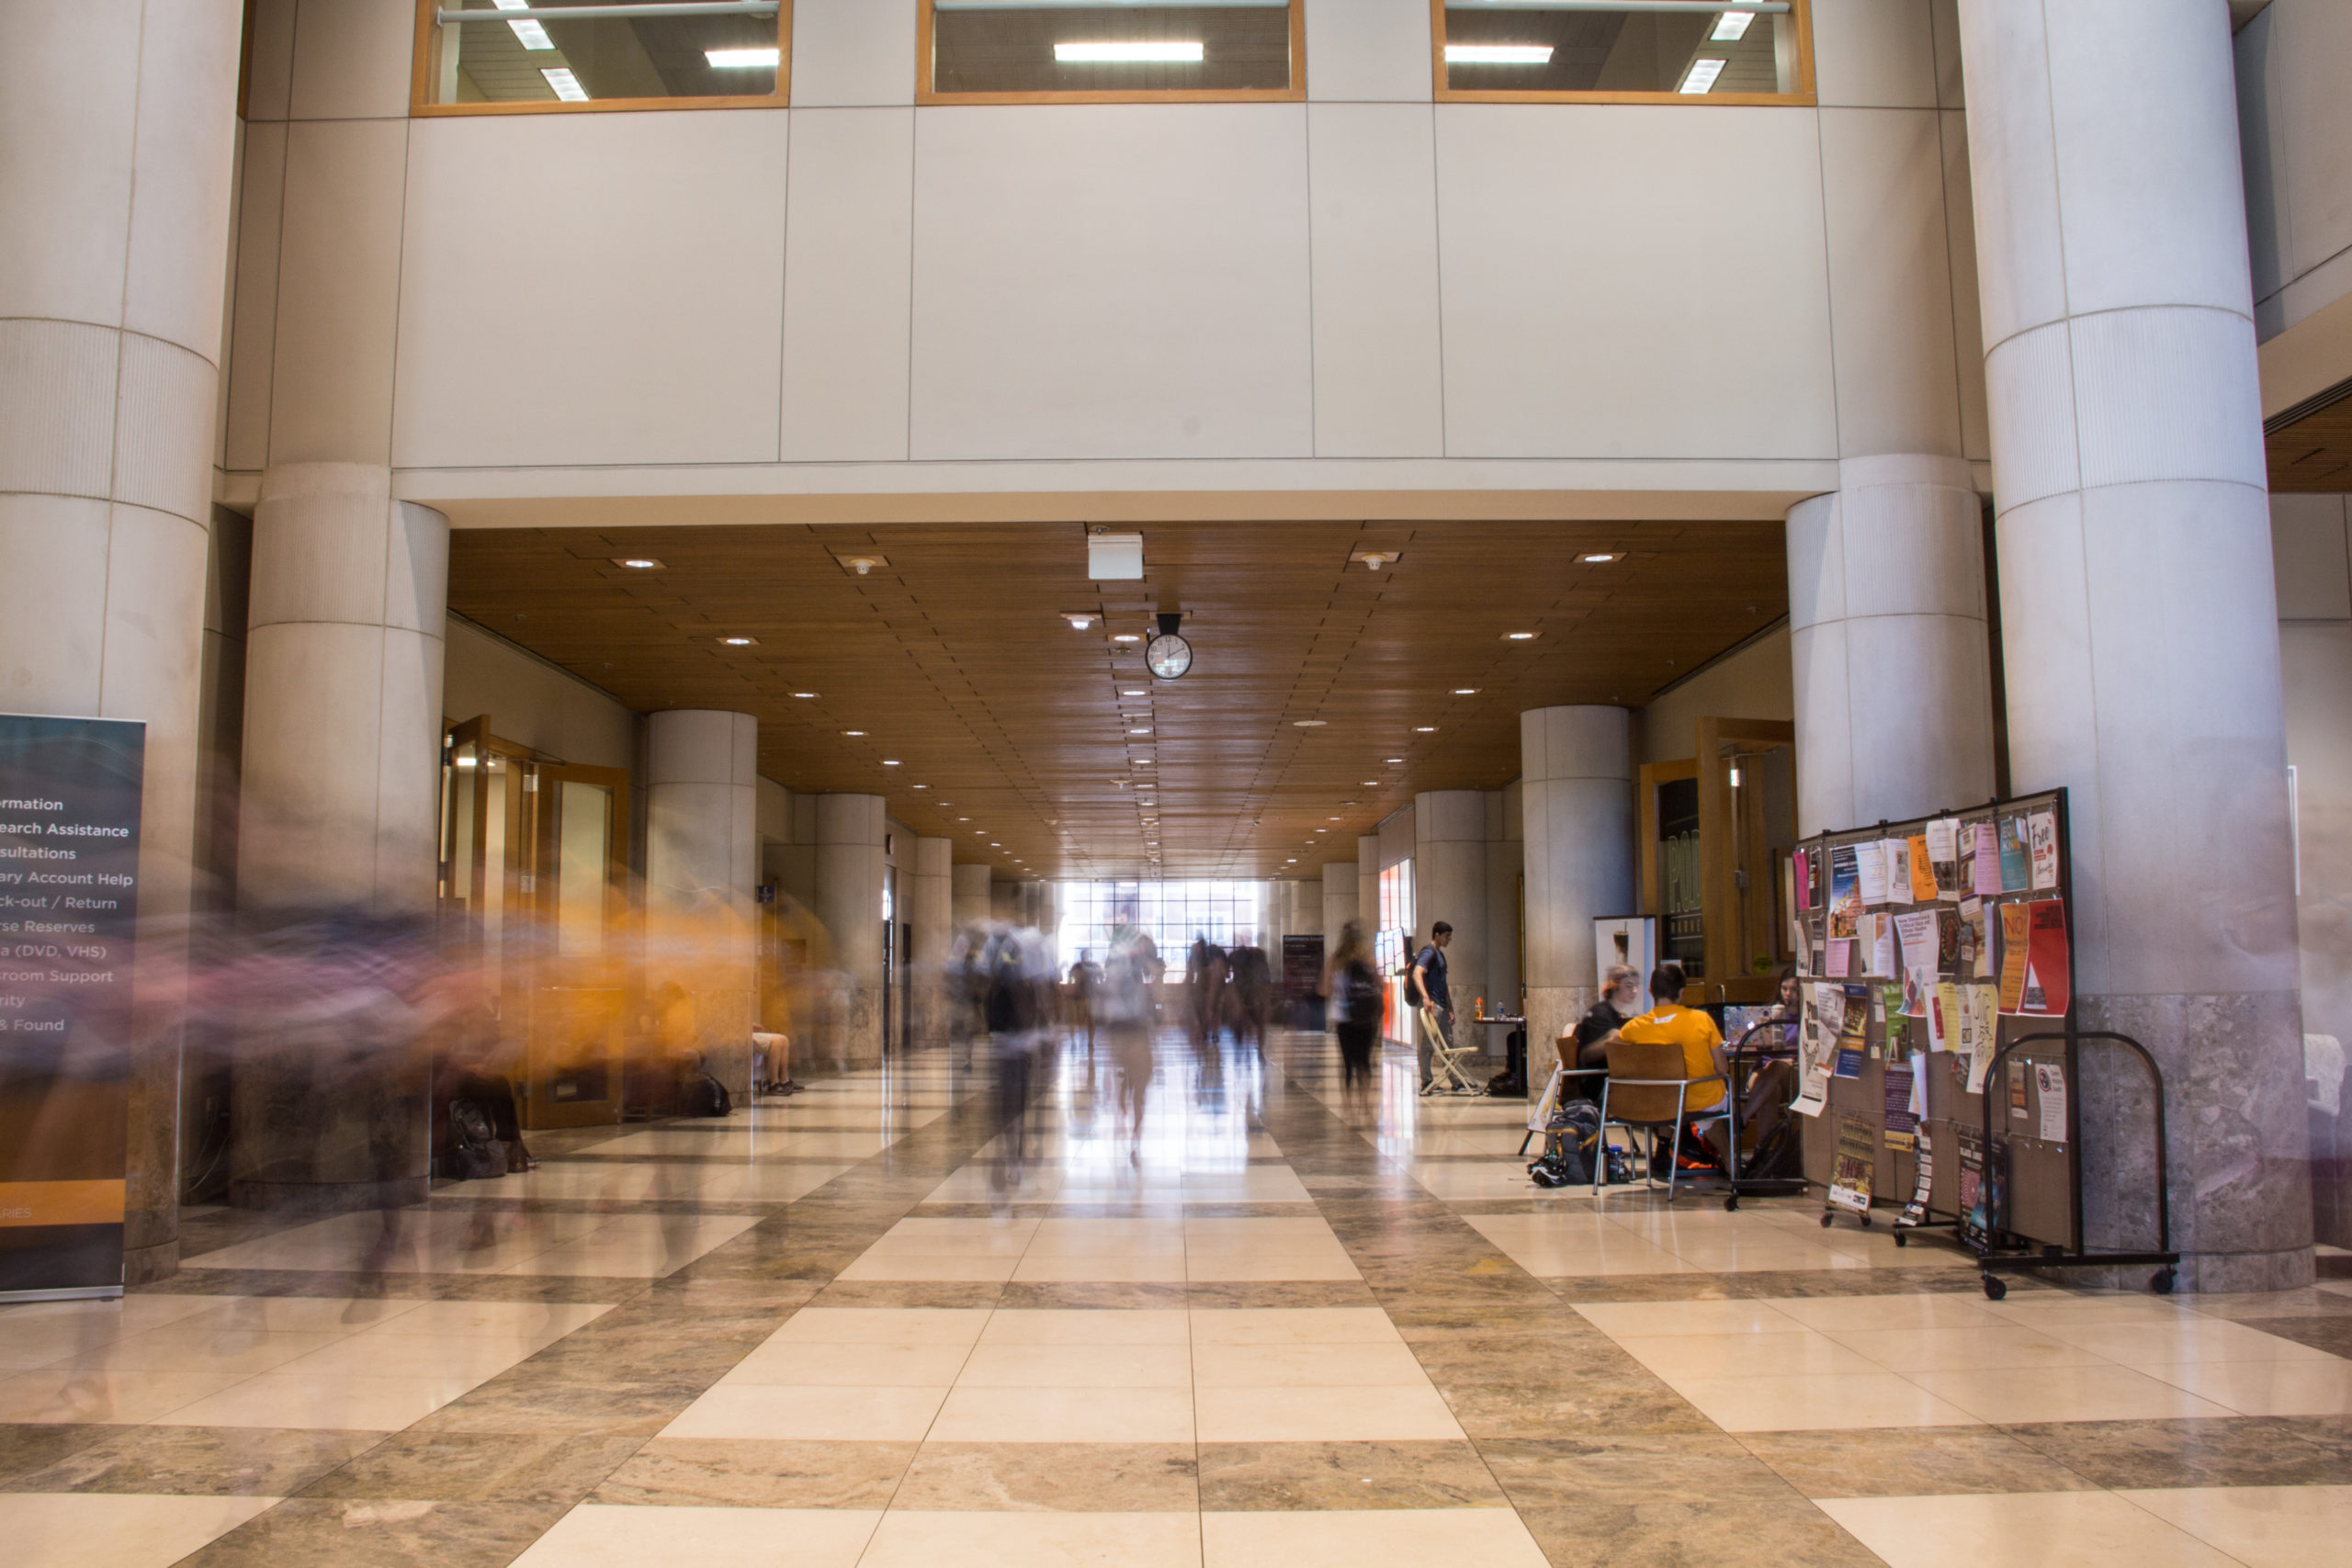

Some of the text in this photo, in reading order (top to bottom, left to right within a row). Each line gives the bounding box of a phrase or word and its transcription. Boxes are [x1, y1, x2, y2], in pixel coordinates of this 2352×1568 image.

[0, 798, 63, 810] rmation
[46, 823, 130, 837] Assistance
[0, 846, 77, 860] sultations
[28, 872, 94, 885] Account
[98, 874, 133, 887] Help
[51, 895, 62, 909] /
[65, 897, 118, 909] Return
[0, 920, 96, 933] se Reserves
[16, 944, 62, 959] (DVD,
[67, 946, 107, 960] VHS)
[0, 971, 113, 985] room Support
[14, 1019, 64, 1031] Found
